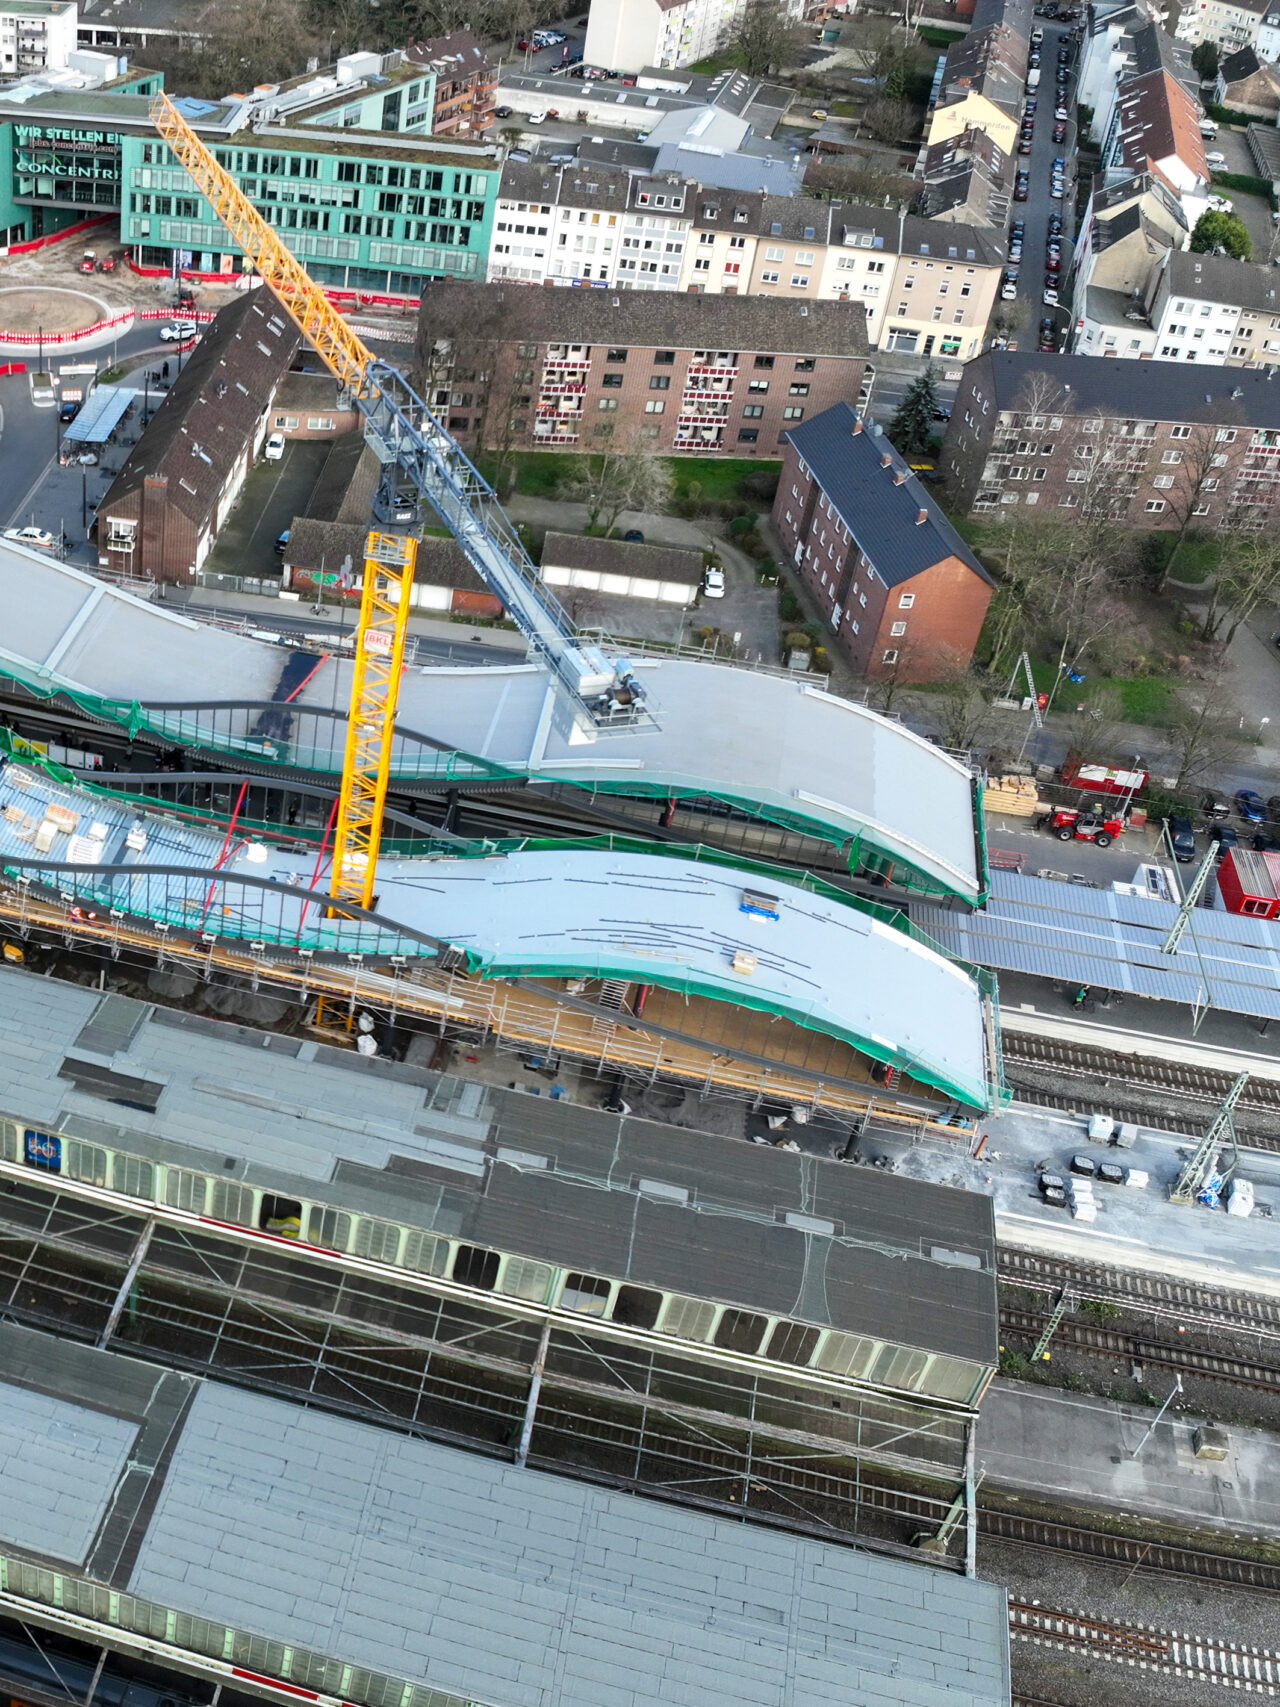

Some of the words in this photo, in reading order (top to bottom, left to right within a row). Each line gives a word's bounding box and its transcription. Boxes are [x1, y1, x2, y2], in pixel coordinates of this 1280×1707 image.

[14, 125, 42, 138] WIR
[46, 128, 103, 144] STELLEN
[106, 132, 122, 144] EI
[16, 162, 119, 179] CONCENTRI
[369, 634, 389, 646] BKL
